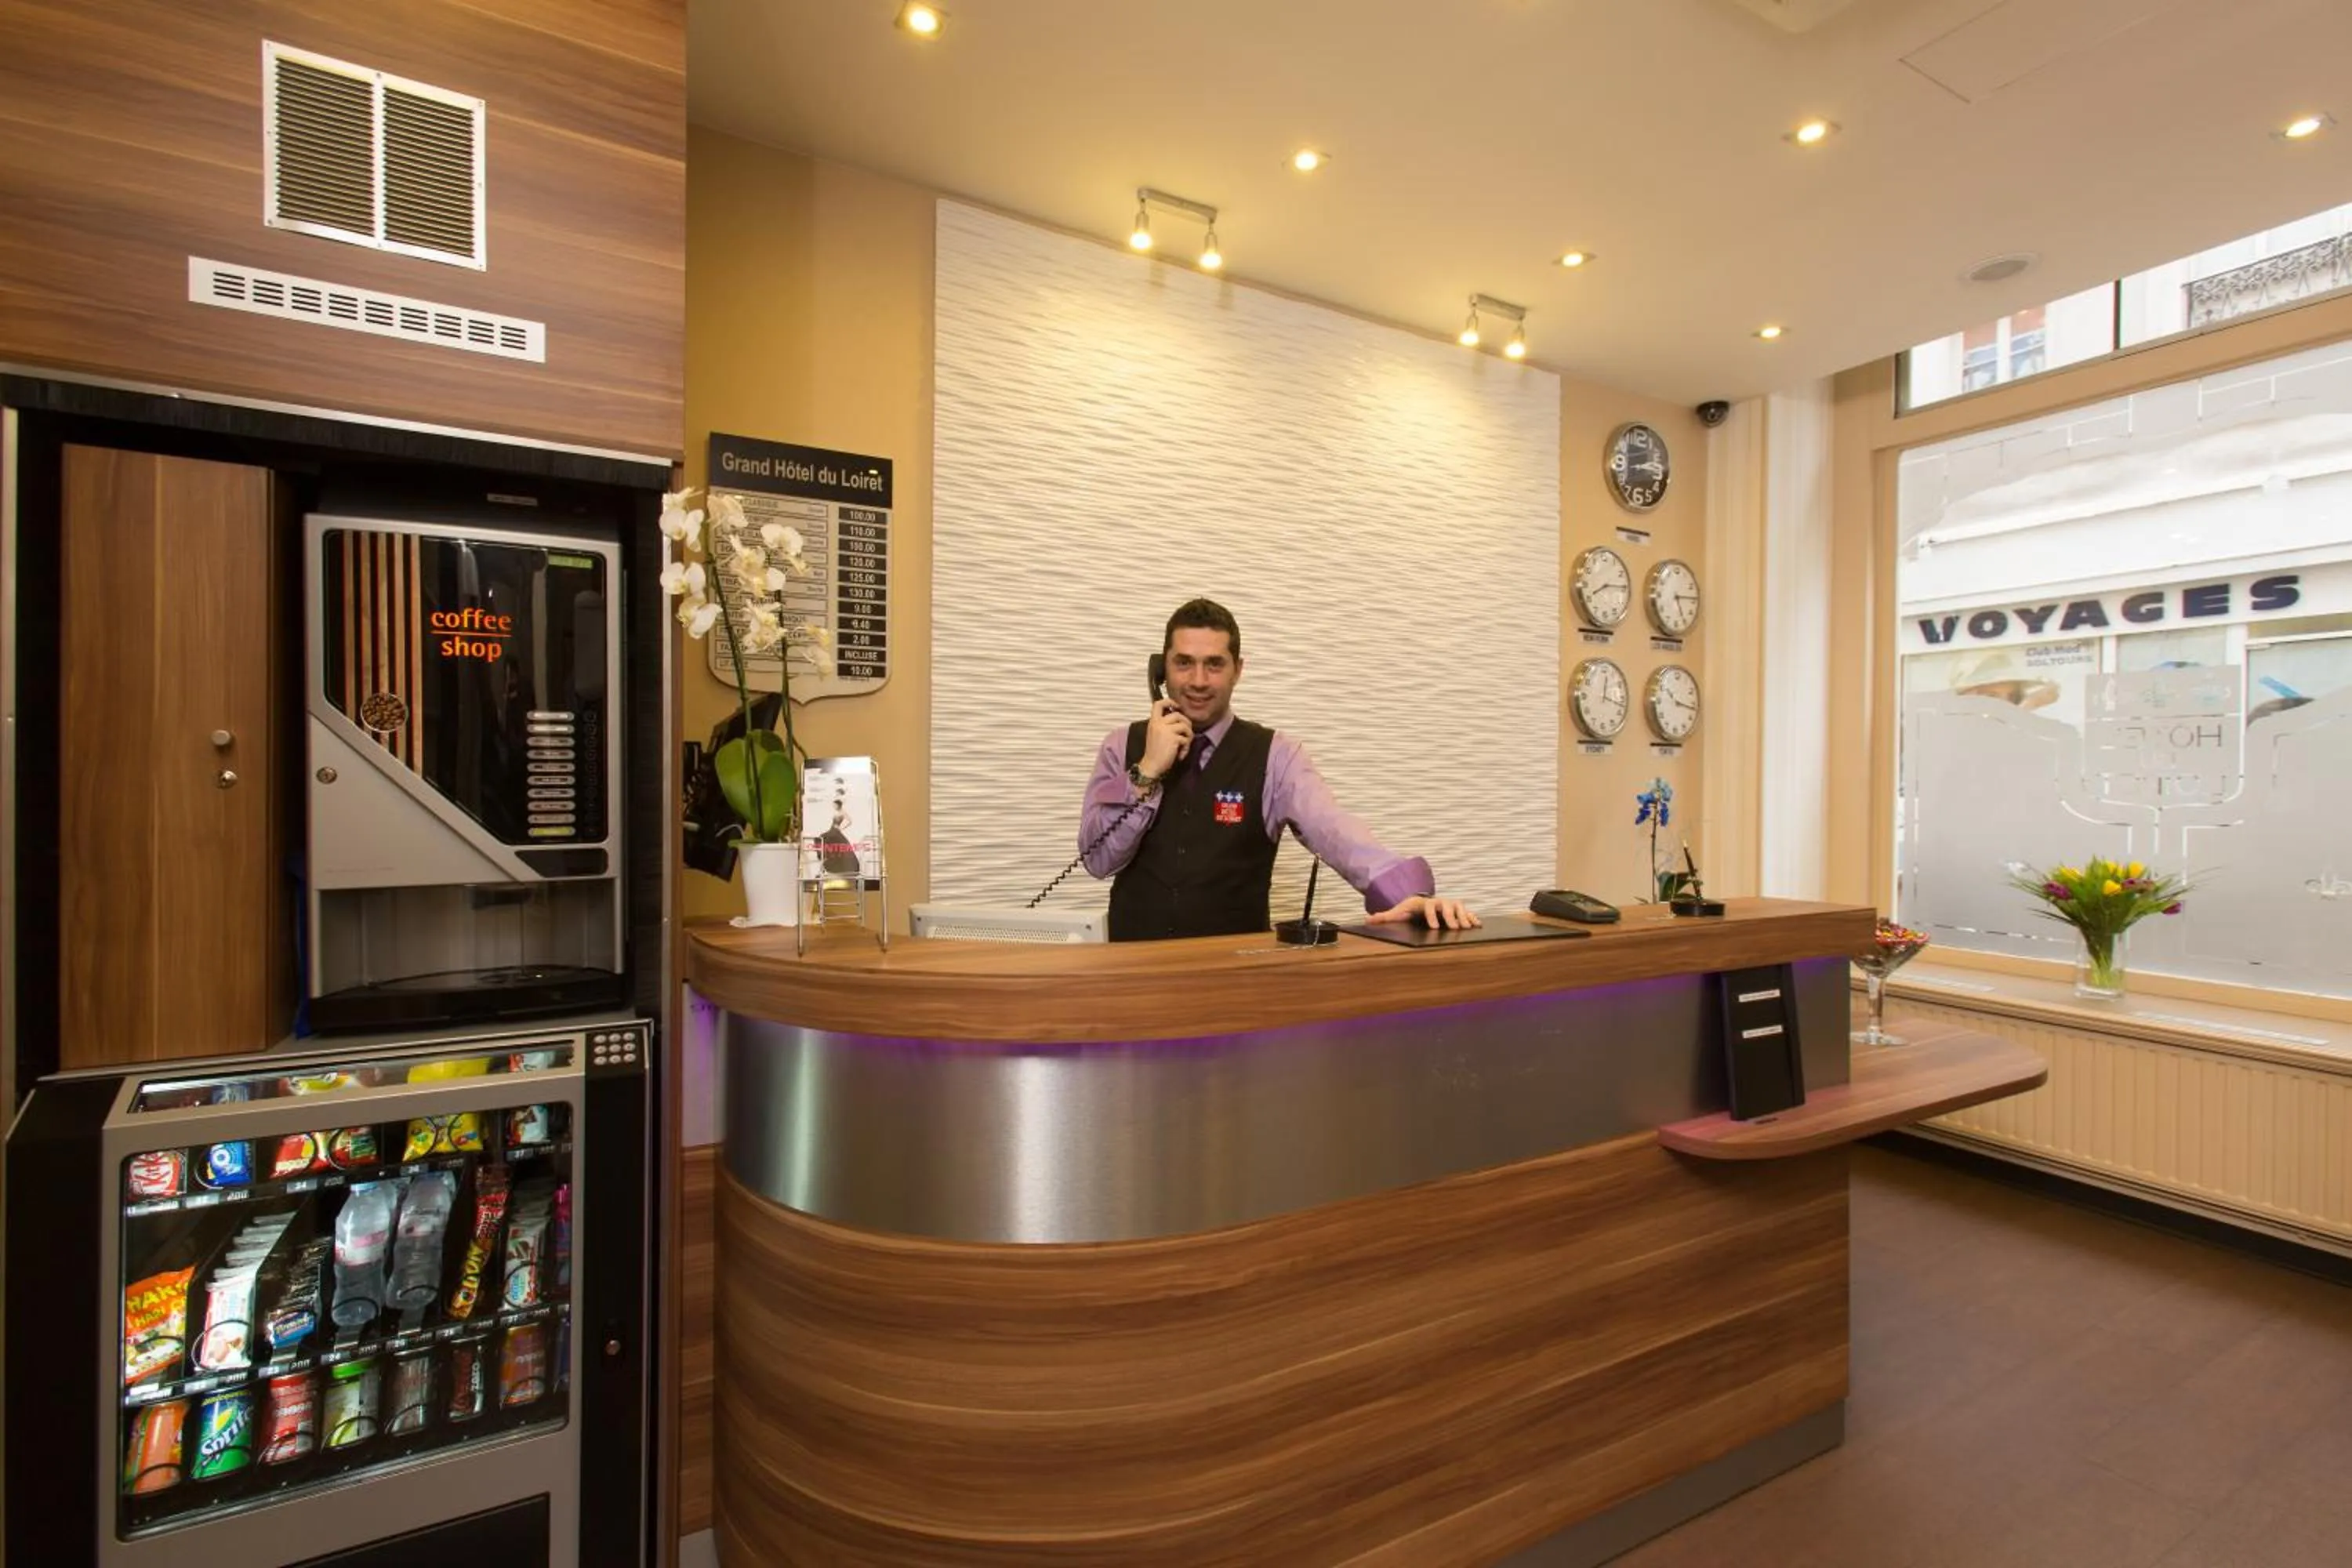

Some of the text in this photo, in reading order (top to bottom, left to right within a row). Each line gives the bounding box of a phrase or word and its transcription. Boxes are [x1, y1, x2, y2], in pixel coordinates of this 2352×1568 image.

[722, 452, 883, 492] Grand Hôtel du Loiret
[431, 607, 512, 630] coffee
[1918, 575, 2301, 644] VOYAGES
[441, 636, 503, 662] shop
[844, 650, 878, 661] INCLUSE
[328, 1352, 341, 1361] 24
